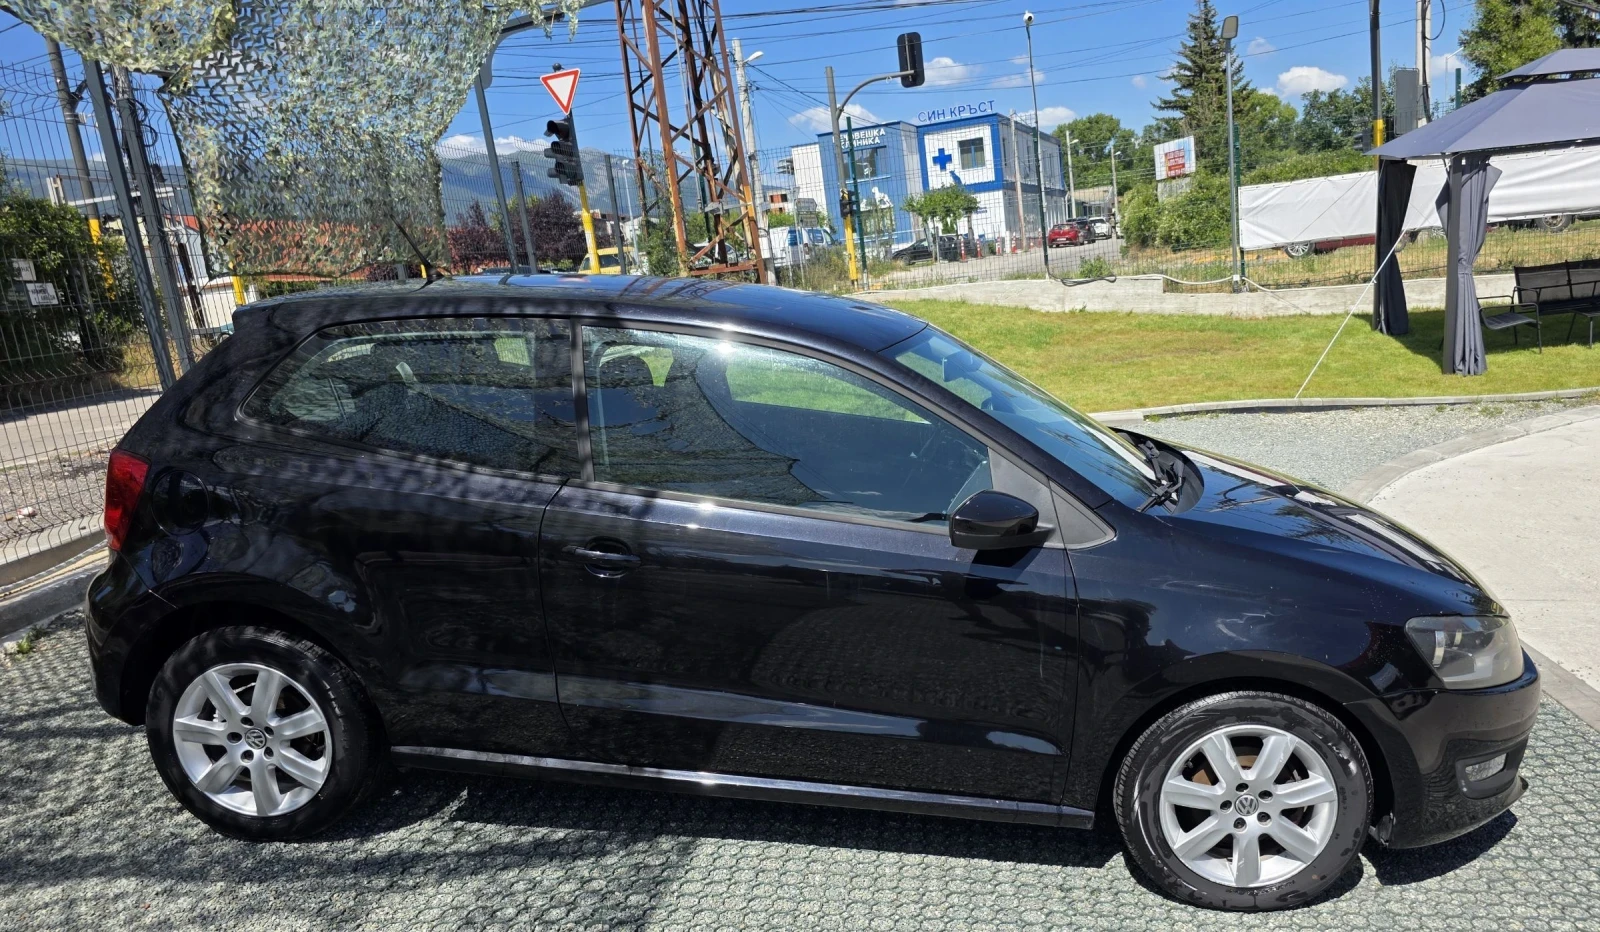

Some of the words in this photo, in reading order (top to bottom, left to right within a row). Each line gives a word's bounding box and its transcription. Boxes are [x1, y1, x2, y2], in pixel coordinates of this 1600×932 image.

[917, 109, 946, 122] СИН
[950, 100, 995, 118] КРЪСТ
[832, 128, 886, 144] ЕЧВЕШКА
